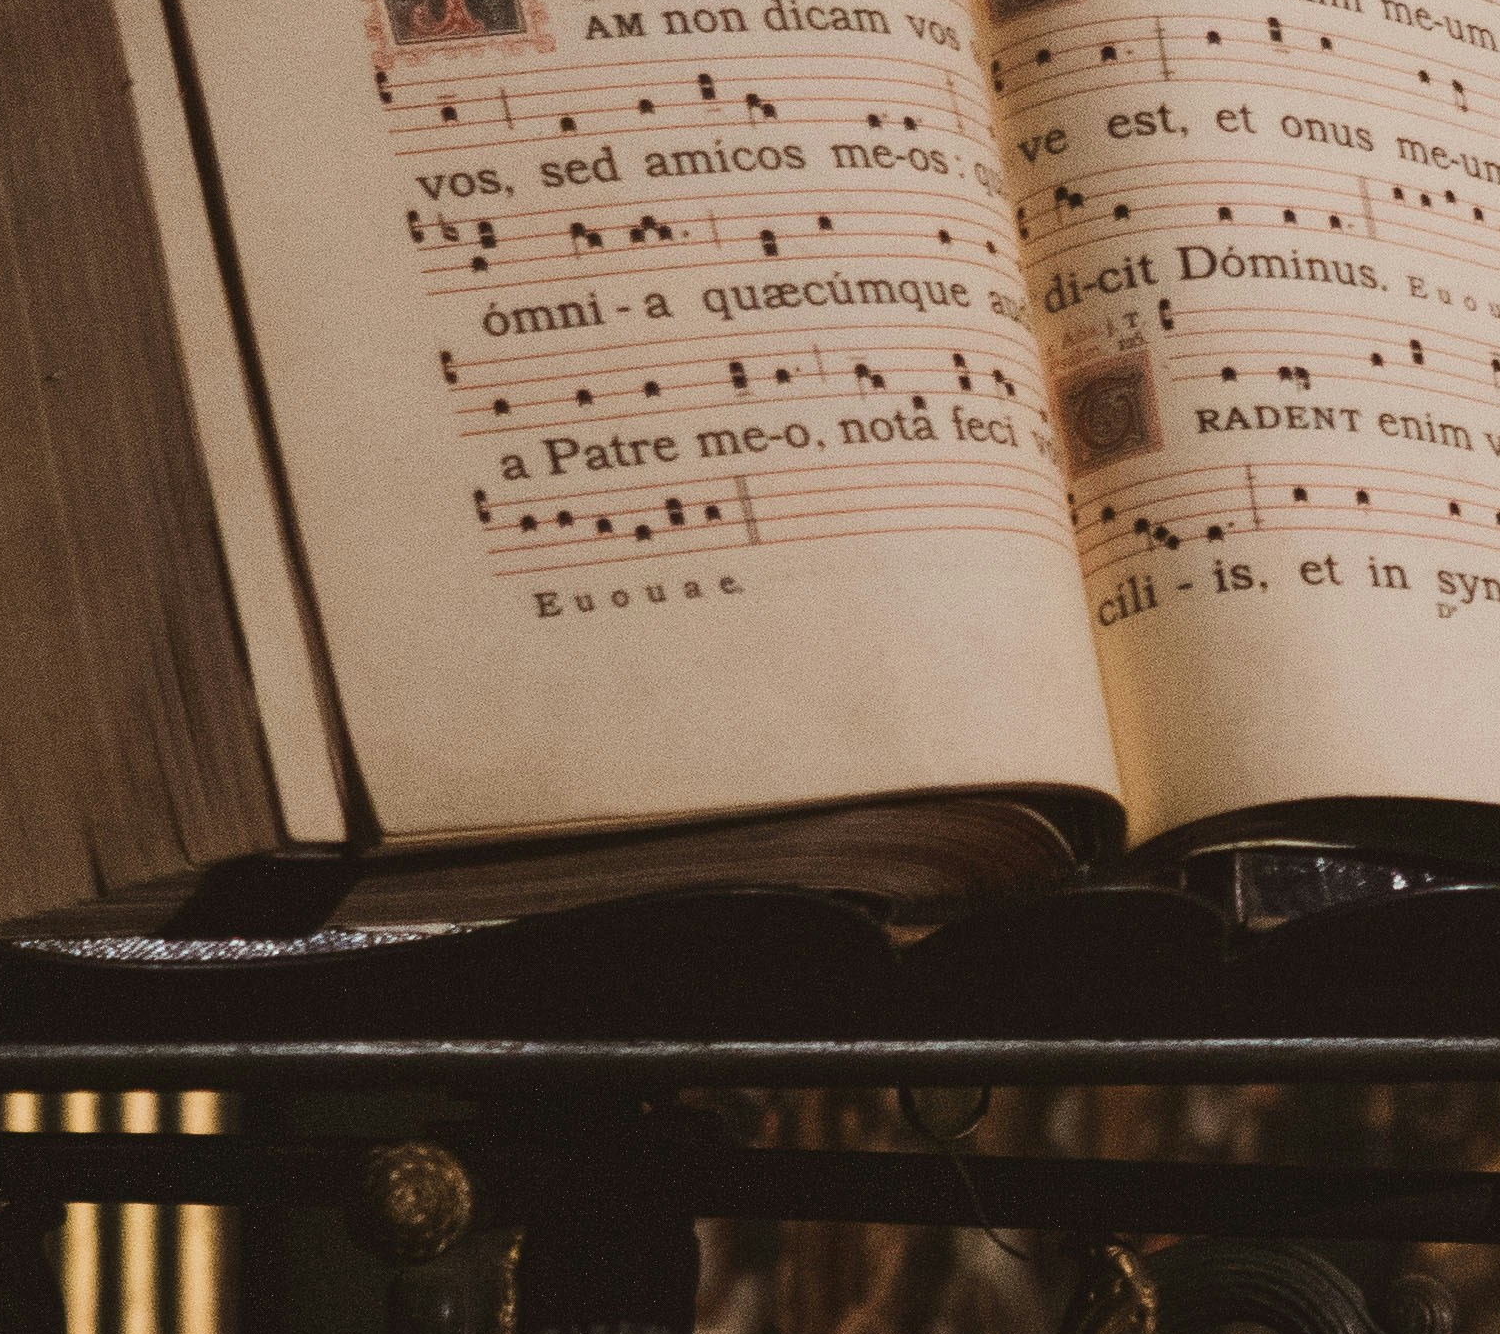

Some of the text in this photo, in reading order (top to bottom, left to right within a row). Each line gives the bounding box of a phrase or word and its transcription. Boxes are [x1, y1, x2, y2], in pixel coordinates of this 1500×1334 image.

[663, 0, 748, 35] non
[905, 14, 963, 54] vos
[1016, 126, 1070, 164] ve
[1105, 102, 1189, 140] est,
[1215, 104, 1257, 136] et
[1280, 111, 1375, 152] onus
[416, 170, 516, 200] vos,
[541, 146, 617, 189] sed
[1176, 244, 1390, 294] Dóminus.
[703, 270, 971, 321] quæcúmque
[500, 453, 531, 482] a
[542, 434, 680, 476] Patre
[952, 405, 1019, 448] feci
[1195, 406, 1362, 435] RADENT
[1378, 408, 1474, 451] enim
[1300, 553, 1340, 588] et
[1368, 555, 1411, 591] in
